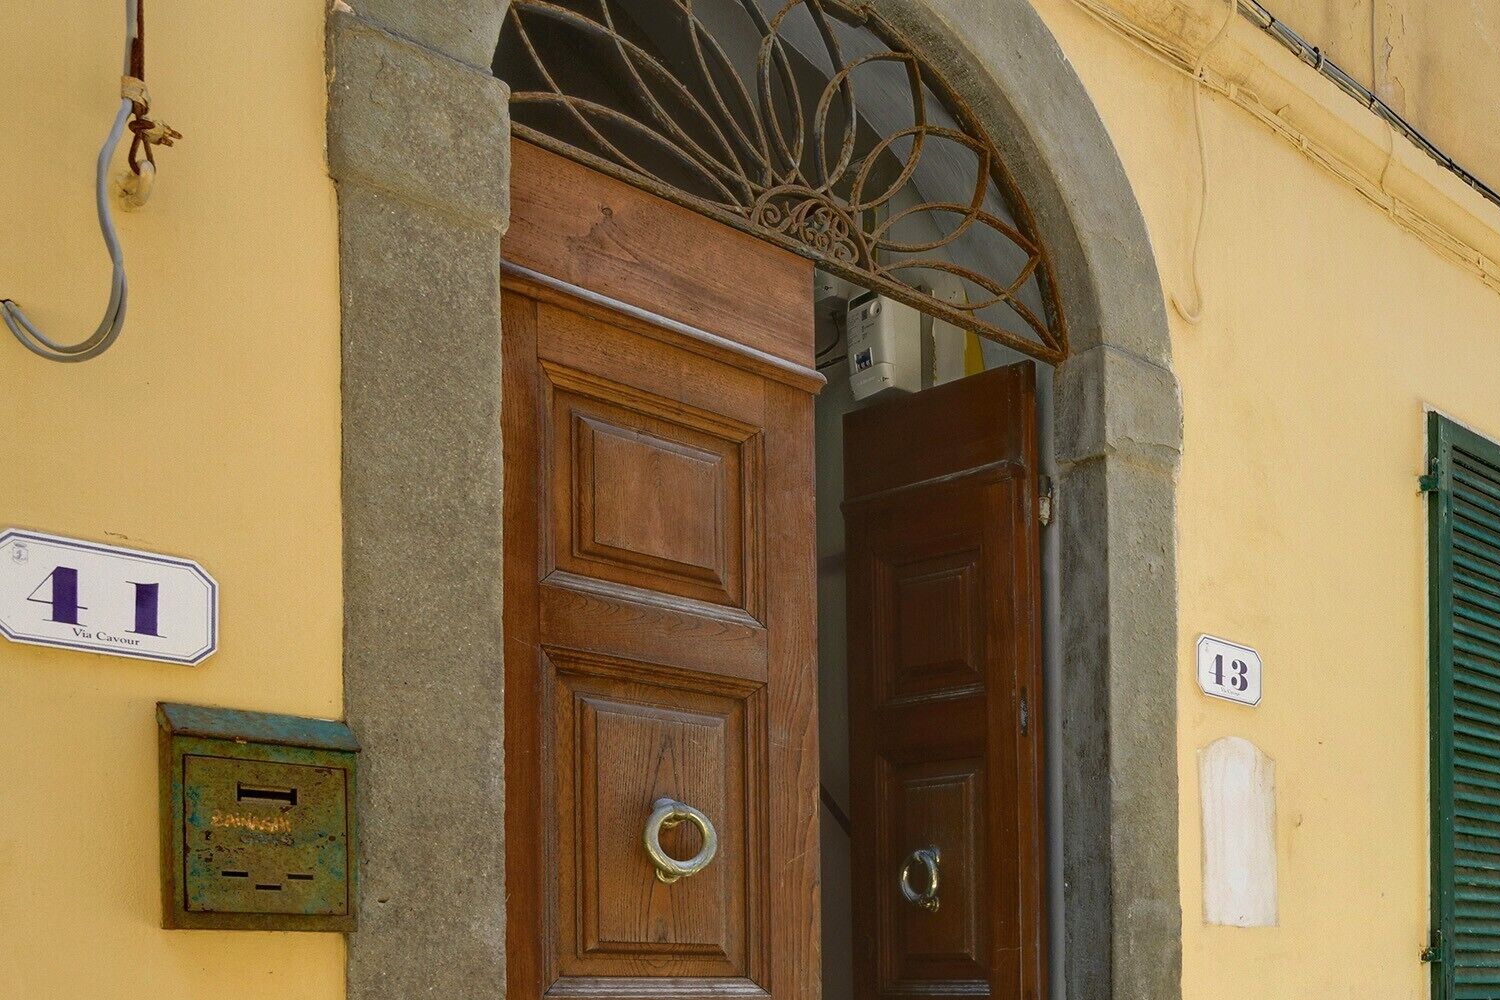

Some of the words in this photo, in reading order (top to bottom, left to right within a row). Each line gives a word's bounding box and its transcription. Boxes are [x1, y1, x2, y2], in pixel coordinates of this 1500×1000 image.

[27, 566, 167, 638] 41
[72, 627, 92, 639] Via
[96, 632, 140, 646] Cavour
[1208, 653, 1249, 692] 43
